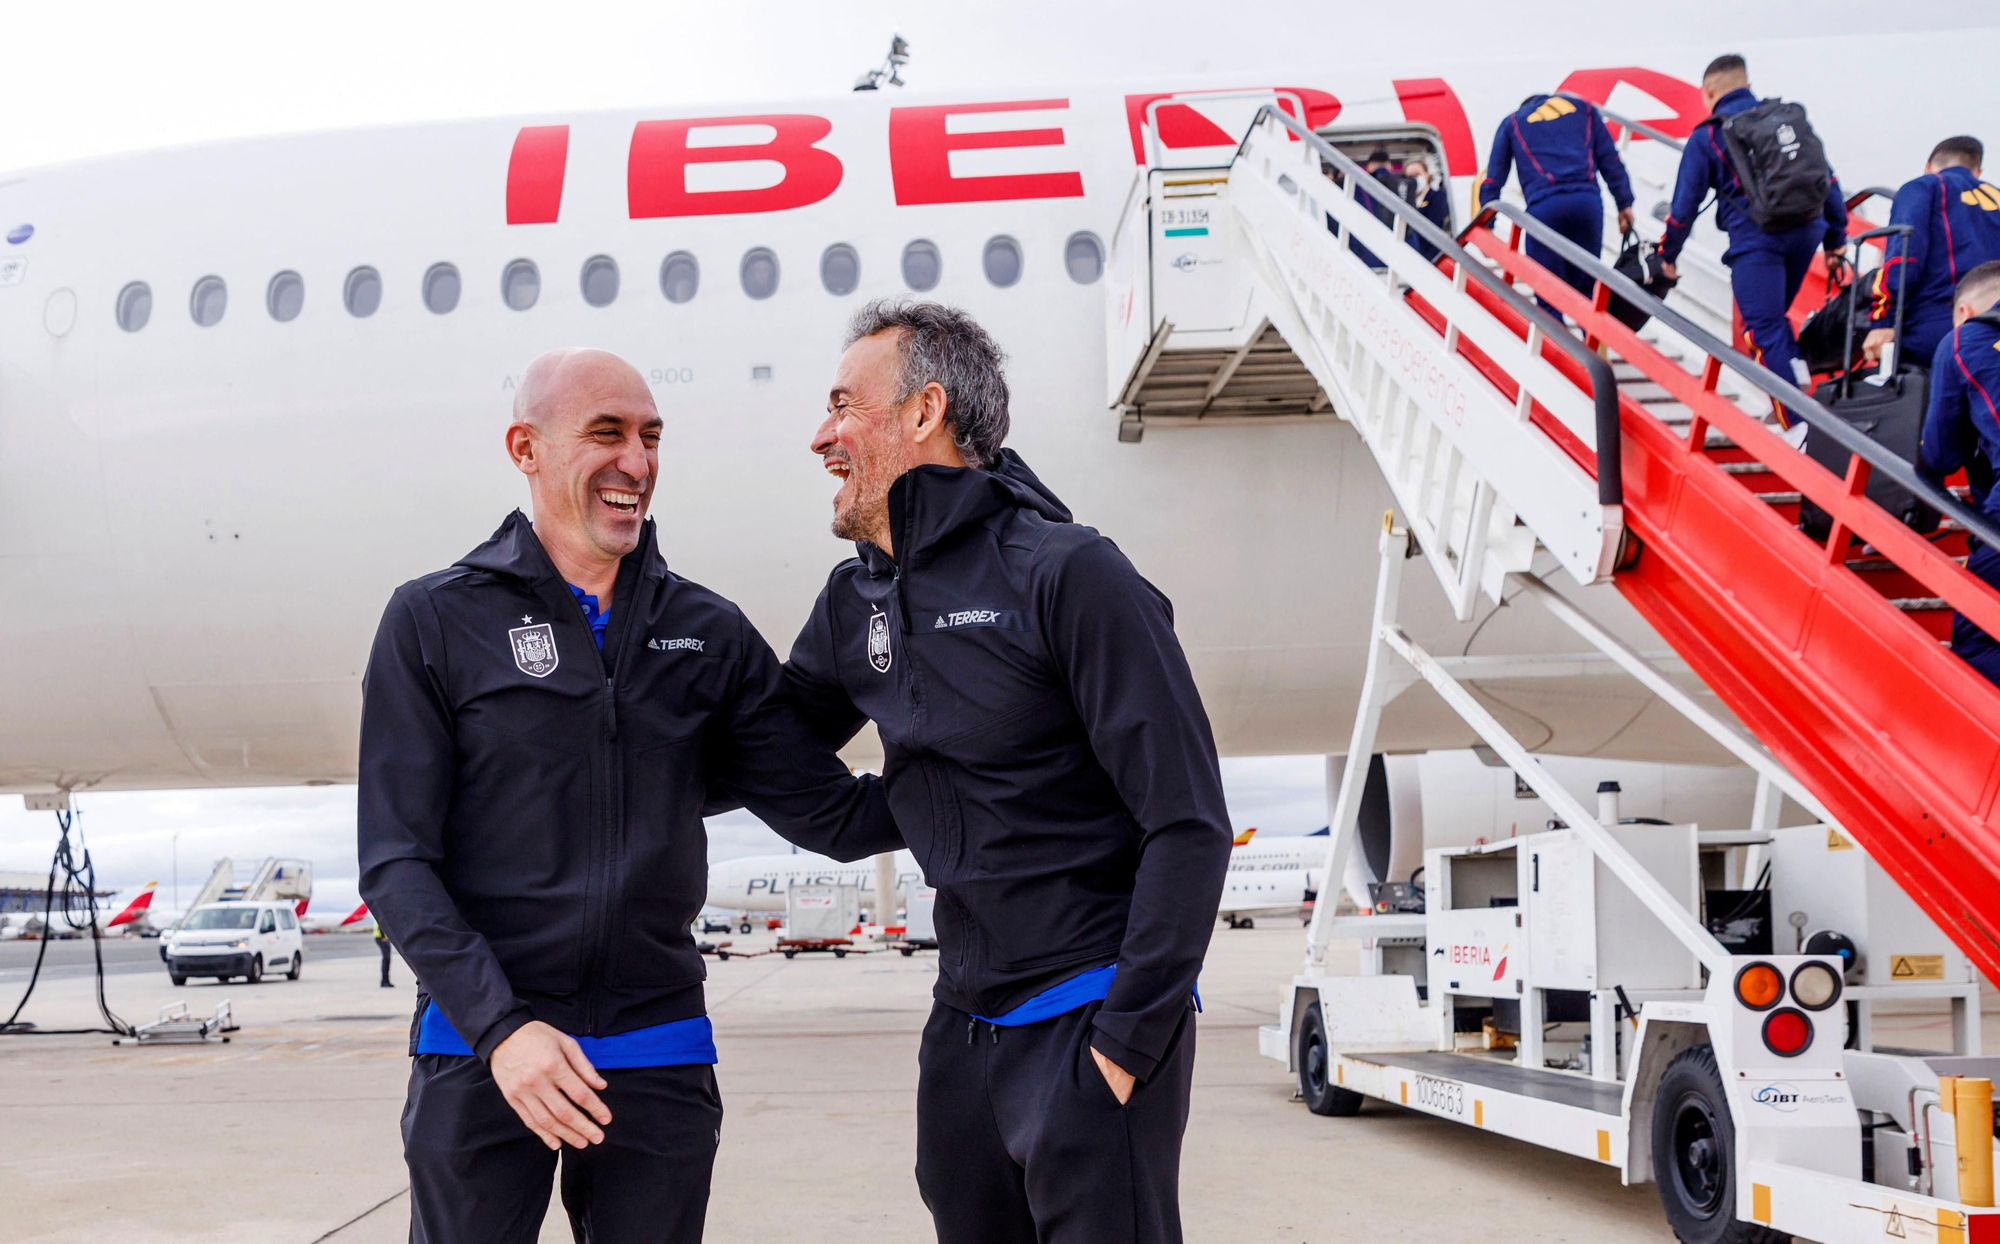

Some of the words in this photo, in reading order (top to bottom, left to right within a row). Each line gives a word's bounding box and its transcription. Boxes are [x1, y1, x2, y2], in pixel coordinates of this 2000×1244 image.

[947, 610, 1001, 627] TERREX
[660, 637, 705, 652] TERREX
[1449, 945, 1491, 966] IBERIA
[1416, 1076, 1463, 1115] 1006663
[1772, 1094, 1799, 1103] JBT
[1803, 1094, 1847, 1104] AeroTech
